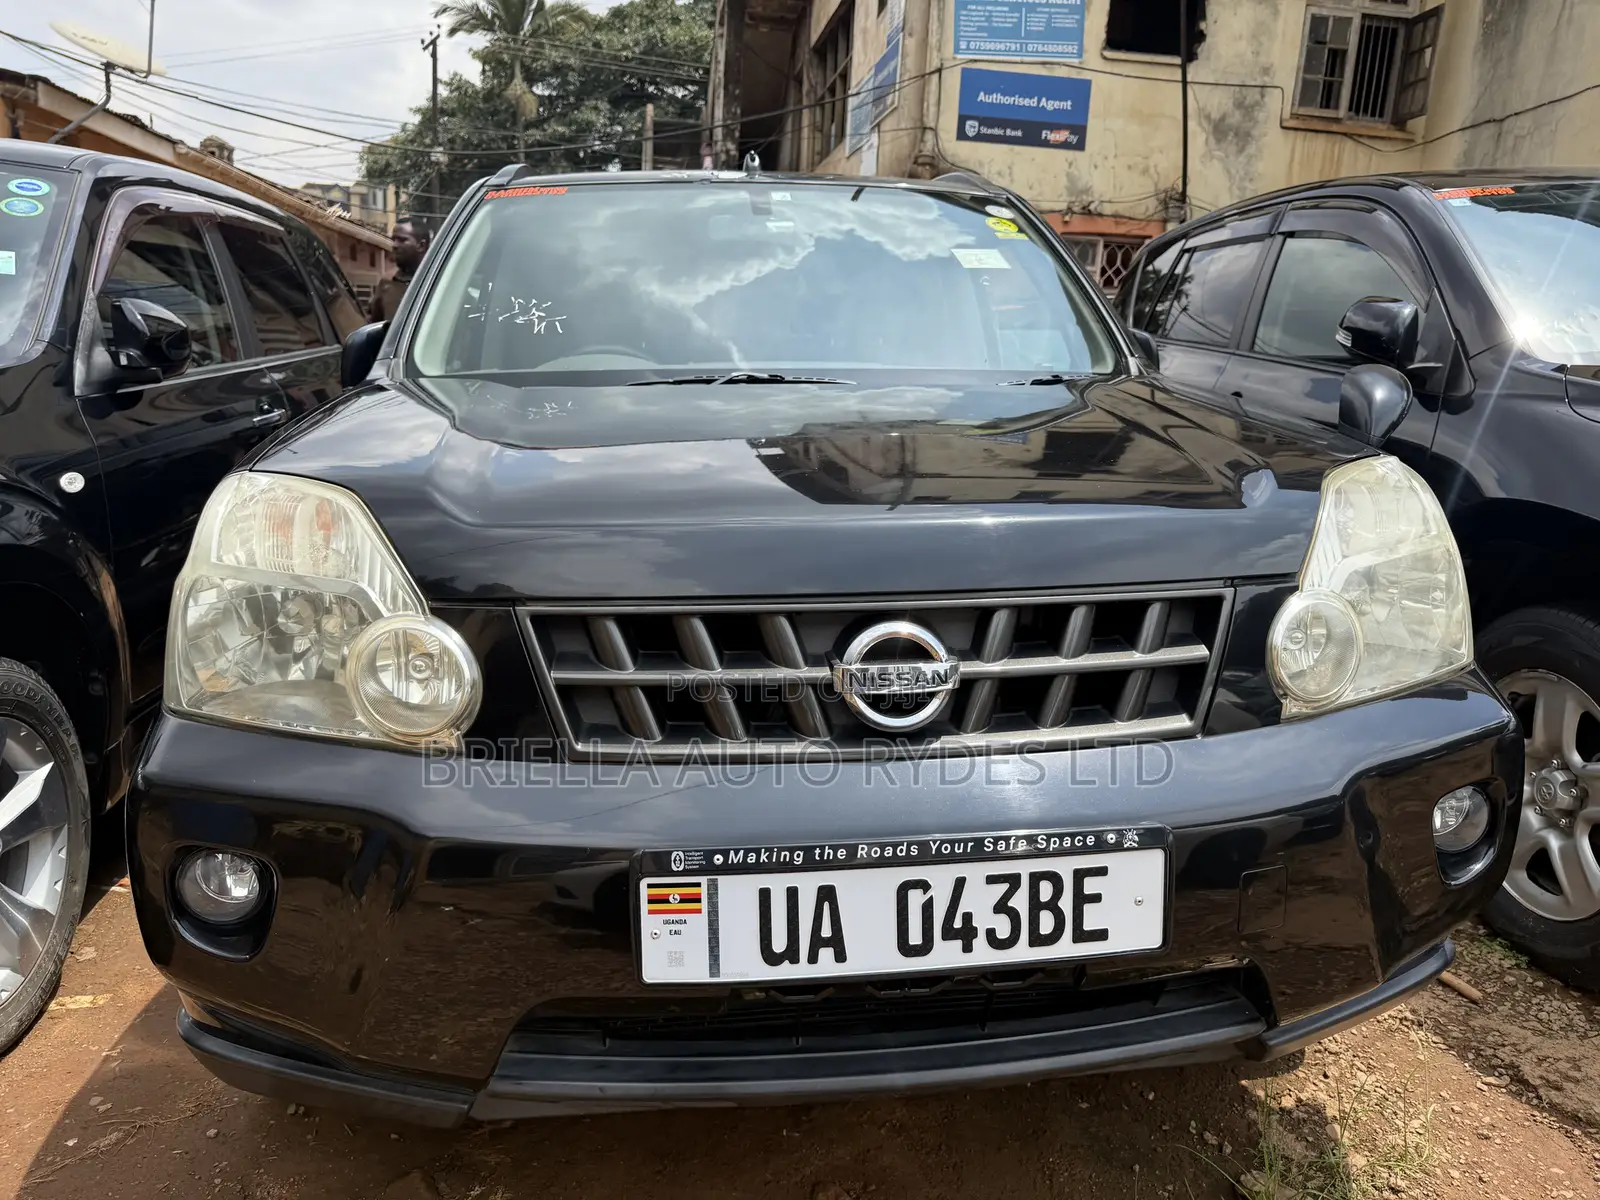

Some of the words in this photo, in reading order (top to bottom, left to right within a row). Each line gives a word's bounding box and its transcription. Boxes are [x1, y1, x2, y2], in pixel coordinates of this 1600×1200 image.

[977, 91, 1038, 107] Authorised
[1039, 98, 1072, 111] Agent
[979, 125, 1005, 136] Stanbic
[1006, 128, 1023, 137] Bank
[849, 669, 948, 688] NISSAN
[728, 849, 805, 865] Making
[814, 845, 848, 860] the
[857, 842, 919, 859] Roads
[929, 840, 975, 855] Your
[983, 836, 1027, 852] Safe
[1037, 834, 1096, 852] Space
[758, 884, 848, 967] UA
[896, 865, 1109, 958] 043BE
